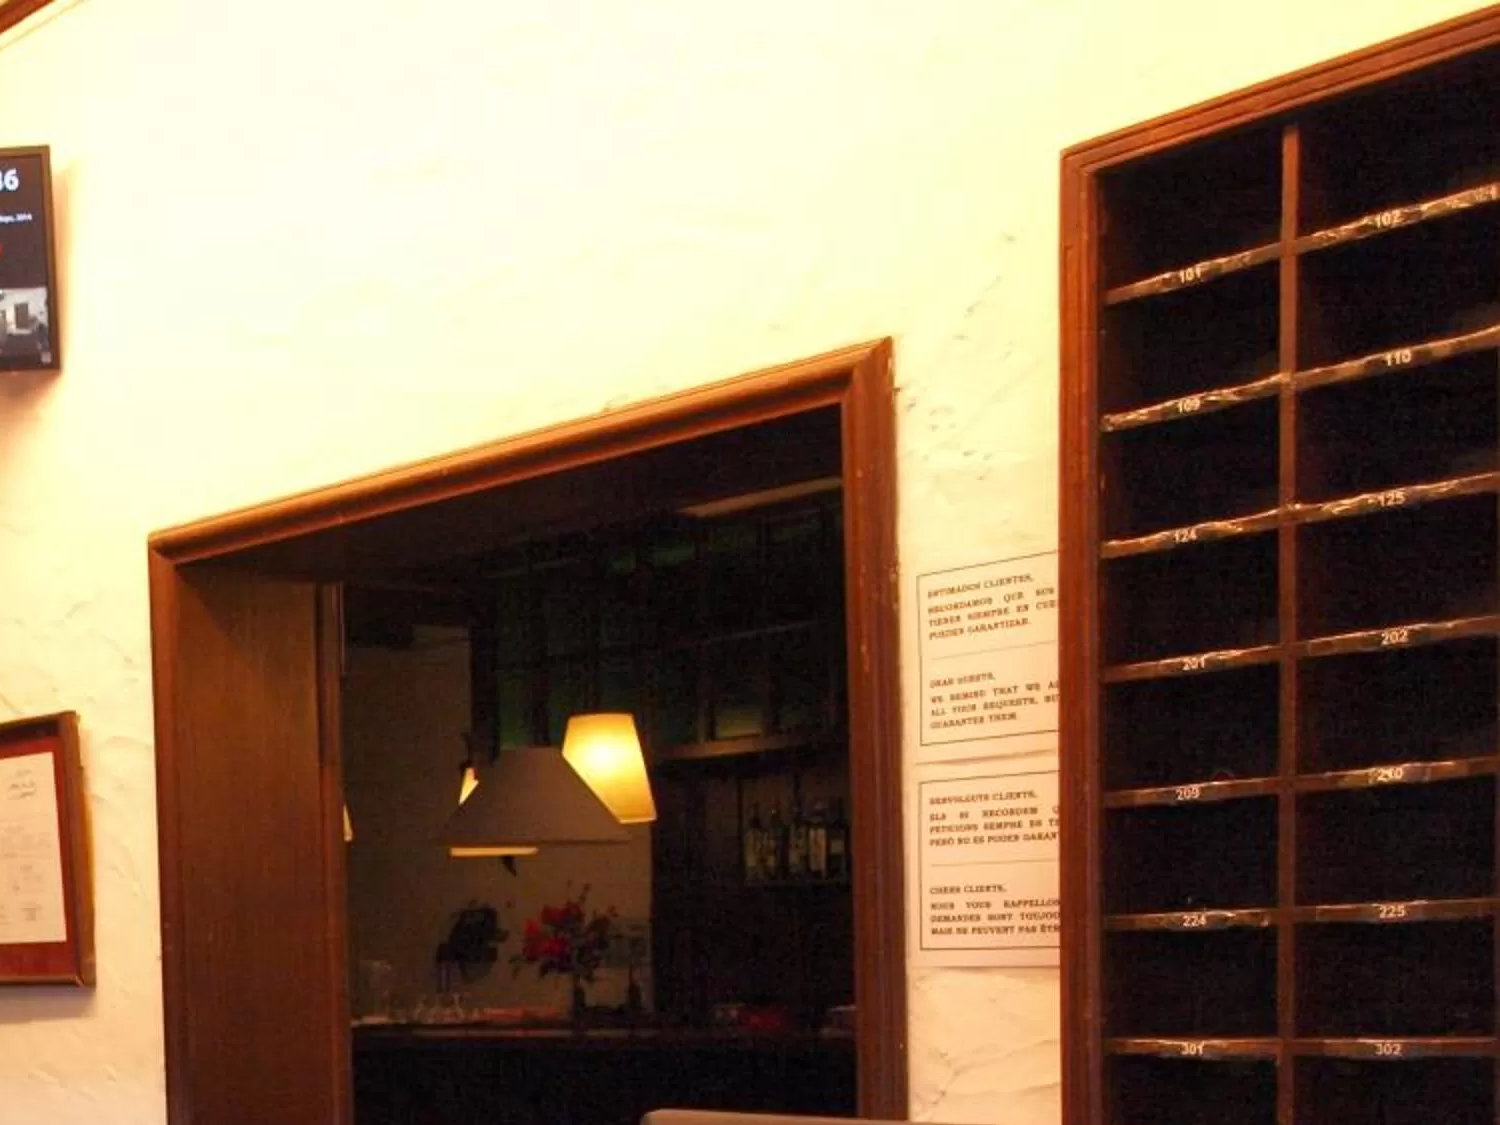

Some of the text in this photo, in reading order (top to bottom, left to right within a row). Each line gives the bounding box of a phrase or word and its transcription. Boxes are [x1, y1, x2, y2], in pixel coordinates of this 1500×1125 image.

[1374, 209, 1401, 229] 102
[1384, 348, 1412, 368] 110
[1378, 491, 1406, 507] 125
[1173, 527, 1198, 543] 124
[1381, 629, 1410, 645] 202
[992, 685, 1019, 697] THAT
[930, 708, 947, 717] ALL
[1175, 786, 1201, 801] 209
[1379, 904, 1406, 919] 225
[1182, 913, 1207, 928] 224
[1180, 1042, 1206, 1056] 301
[1375, 1042, 1402, 1056] 302
